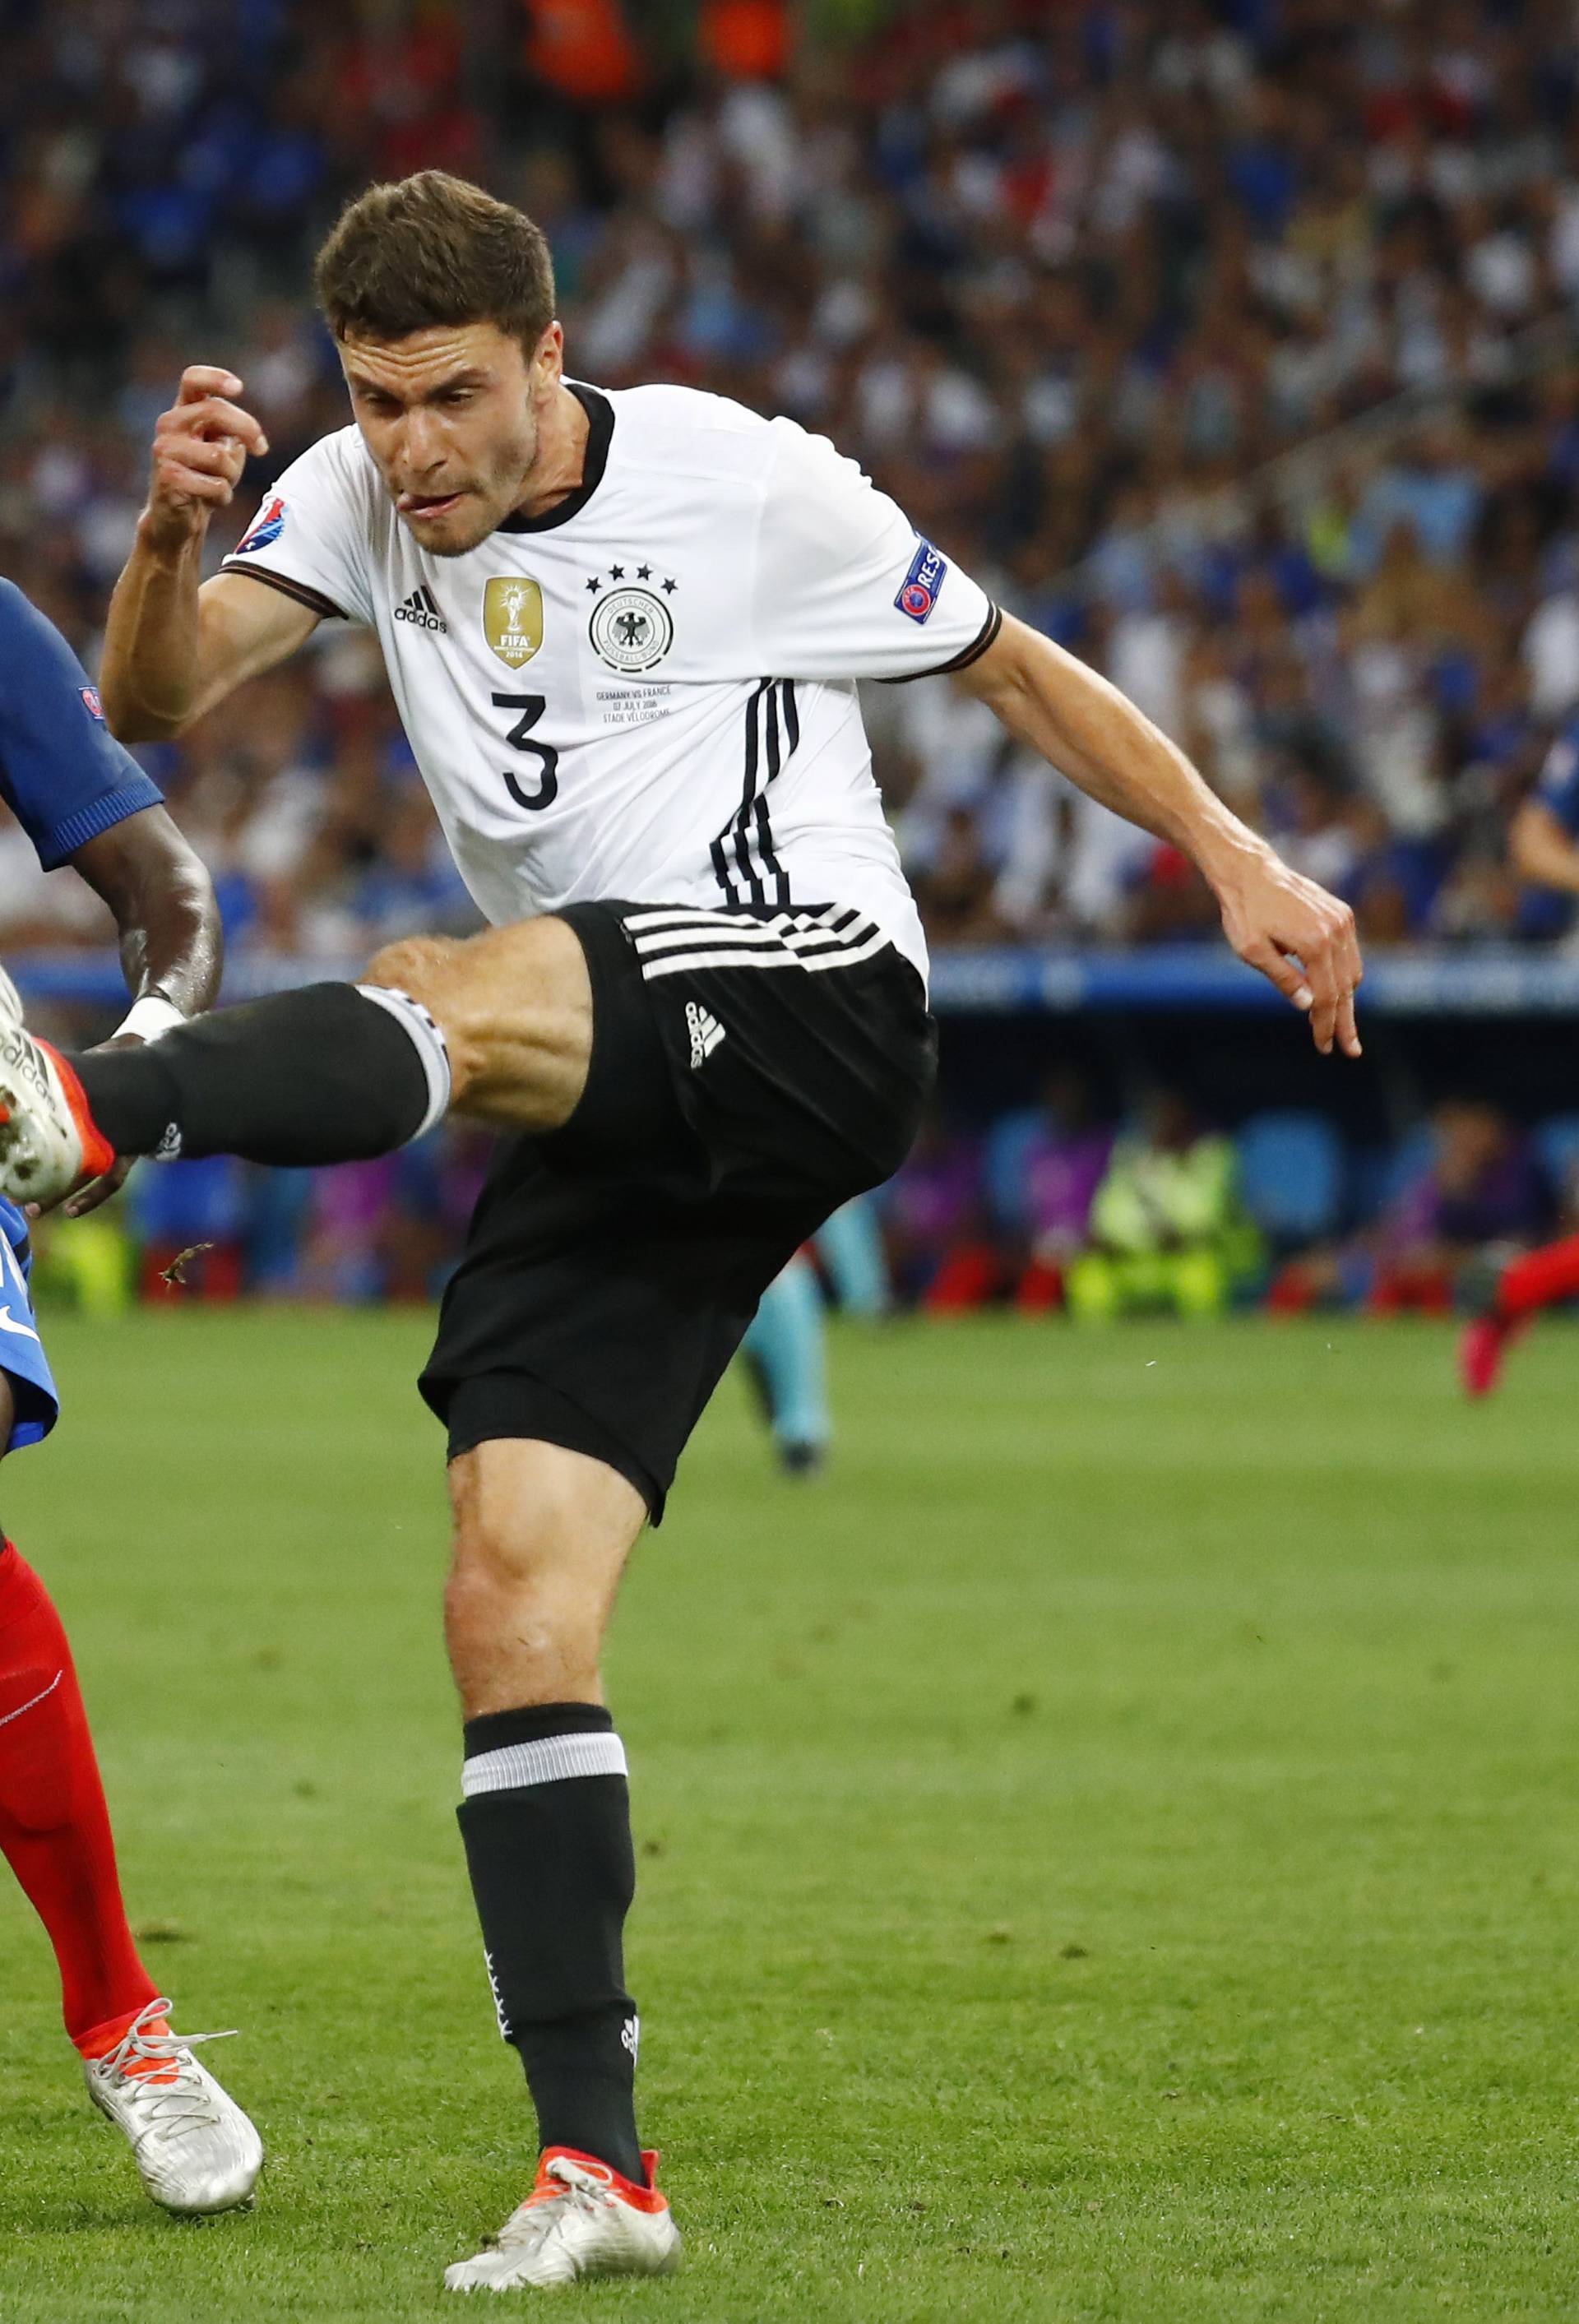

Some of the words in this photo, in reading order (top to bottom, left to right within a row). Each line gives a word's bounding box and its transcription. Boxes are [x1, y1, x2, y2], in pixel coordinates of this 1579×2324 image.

[395, 608, 447, 634] addas
[500, 635, 528, 647] FIFA
[596, 691, 630, 701] GERMANY
[632, 689, 641, 698] VS
[643, 685, 671, 697] FRANCE
[623, 701, 641, 711] JULY
[604, 712, 624, 723] STADE
[492, 692, 558, 810] 3
[0, 1034, 57, 1111] didas
